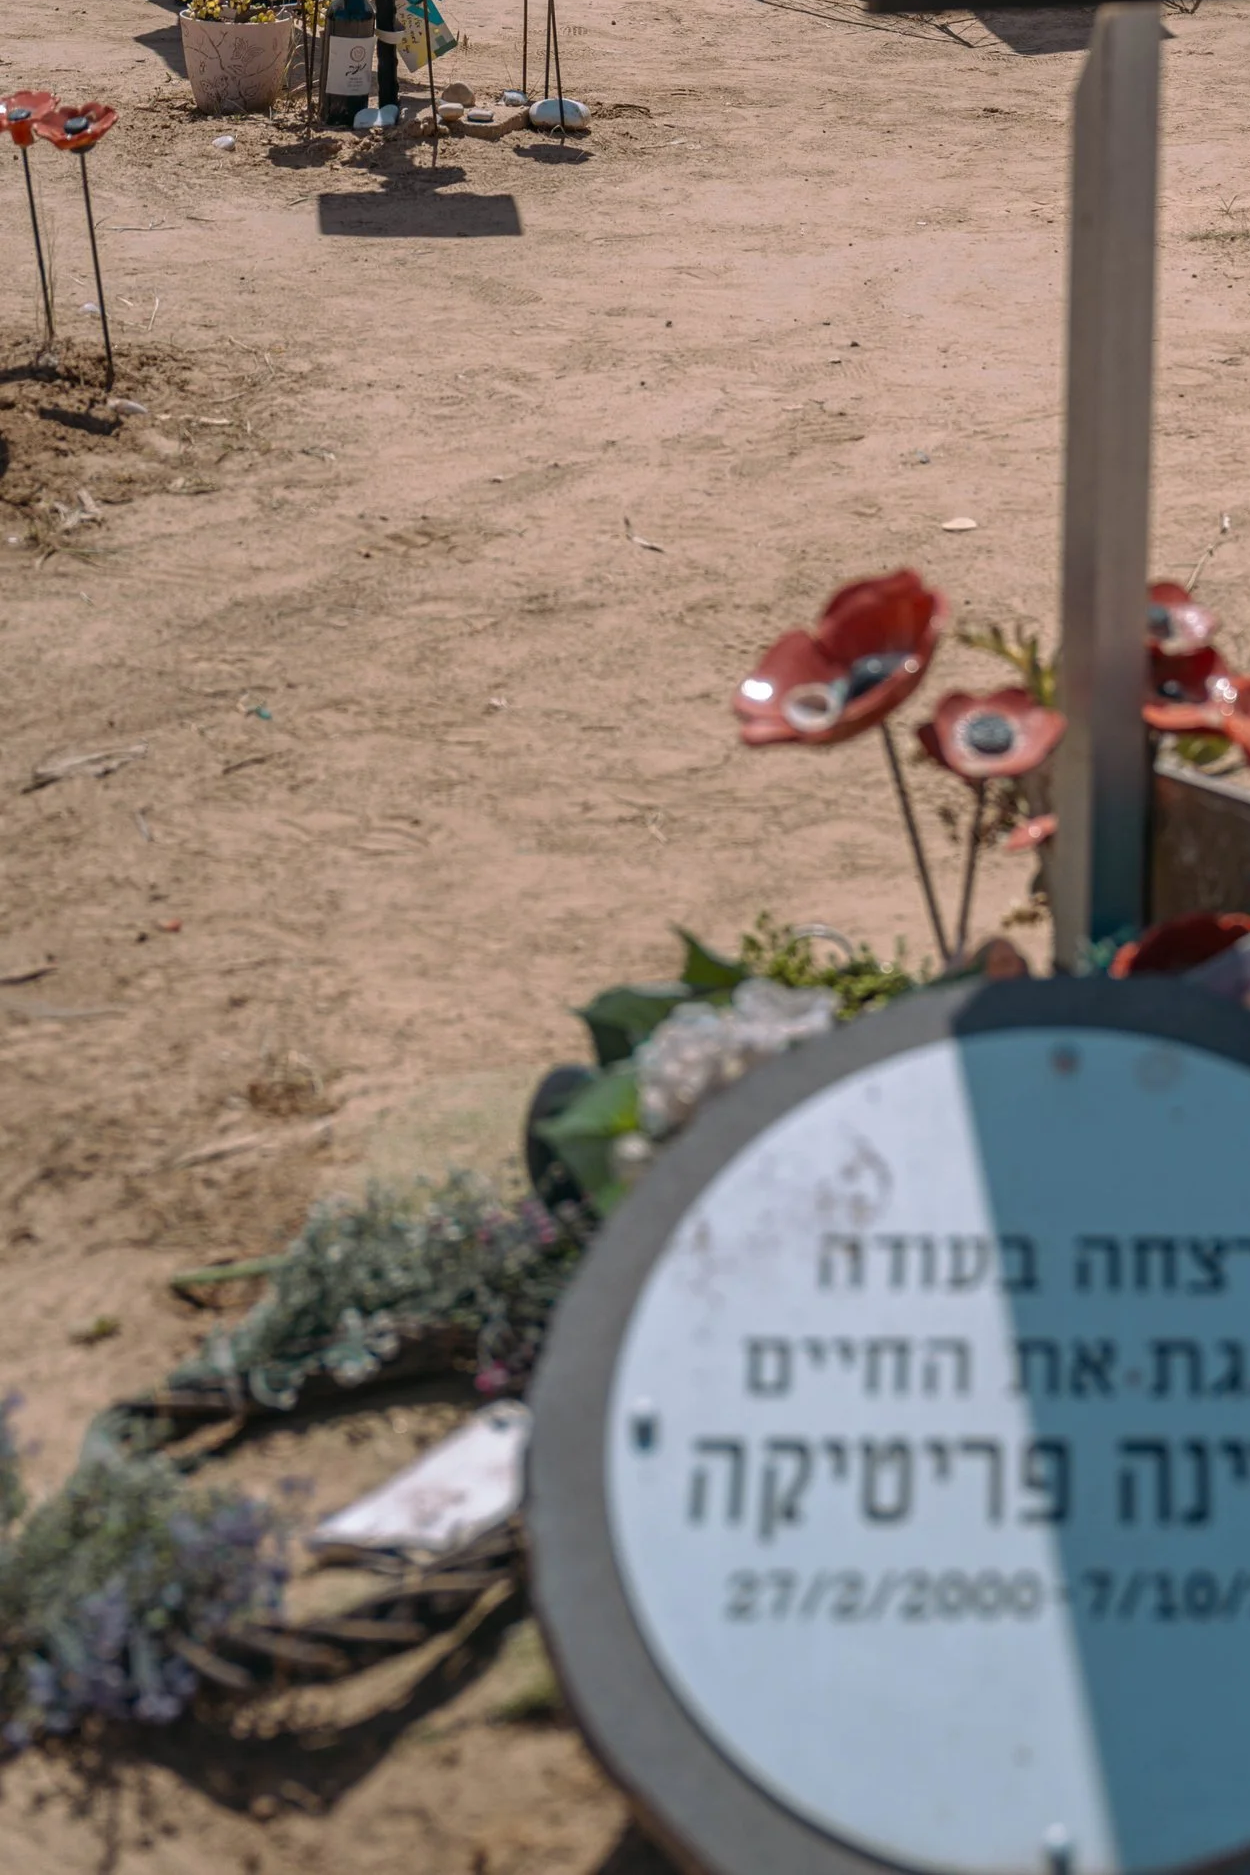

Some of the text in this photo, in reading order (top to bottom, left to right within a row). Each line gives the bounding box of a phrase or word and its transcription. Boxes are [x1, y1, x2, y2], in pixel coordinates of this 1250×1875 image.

[816, 1231, 1041, 1295] בעודה
[744, 1335, 973, 1397] החיים
[1009, 1335, 1118, 1400] את
[688, 1435, 1071, 1544] פריטיקה
[725, 1570, 1043, 1625] 27/2/2000
